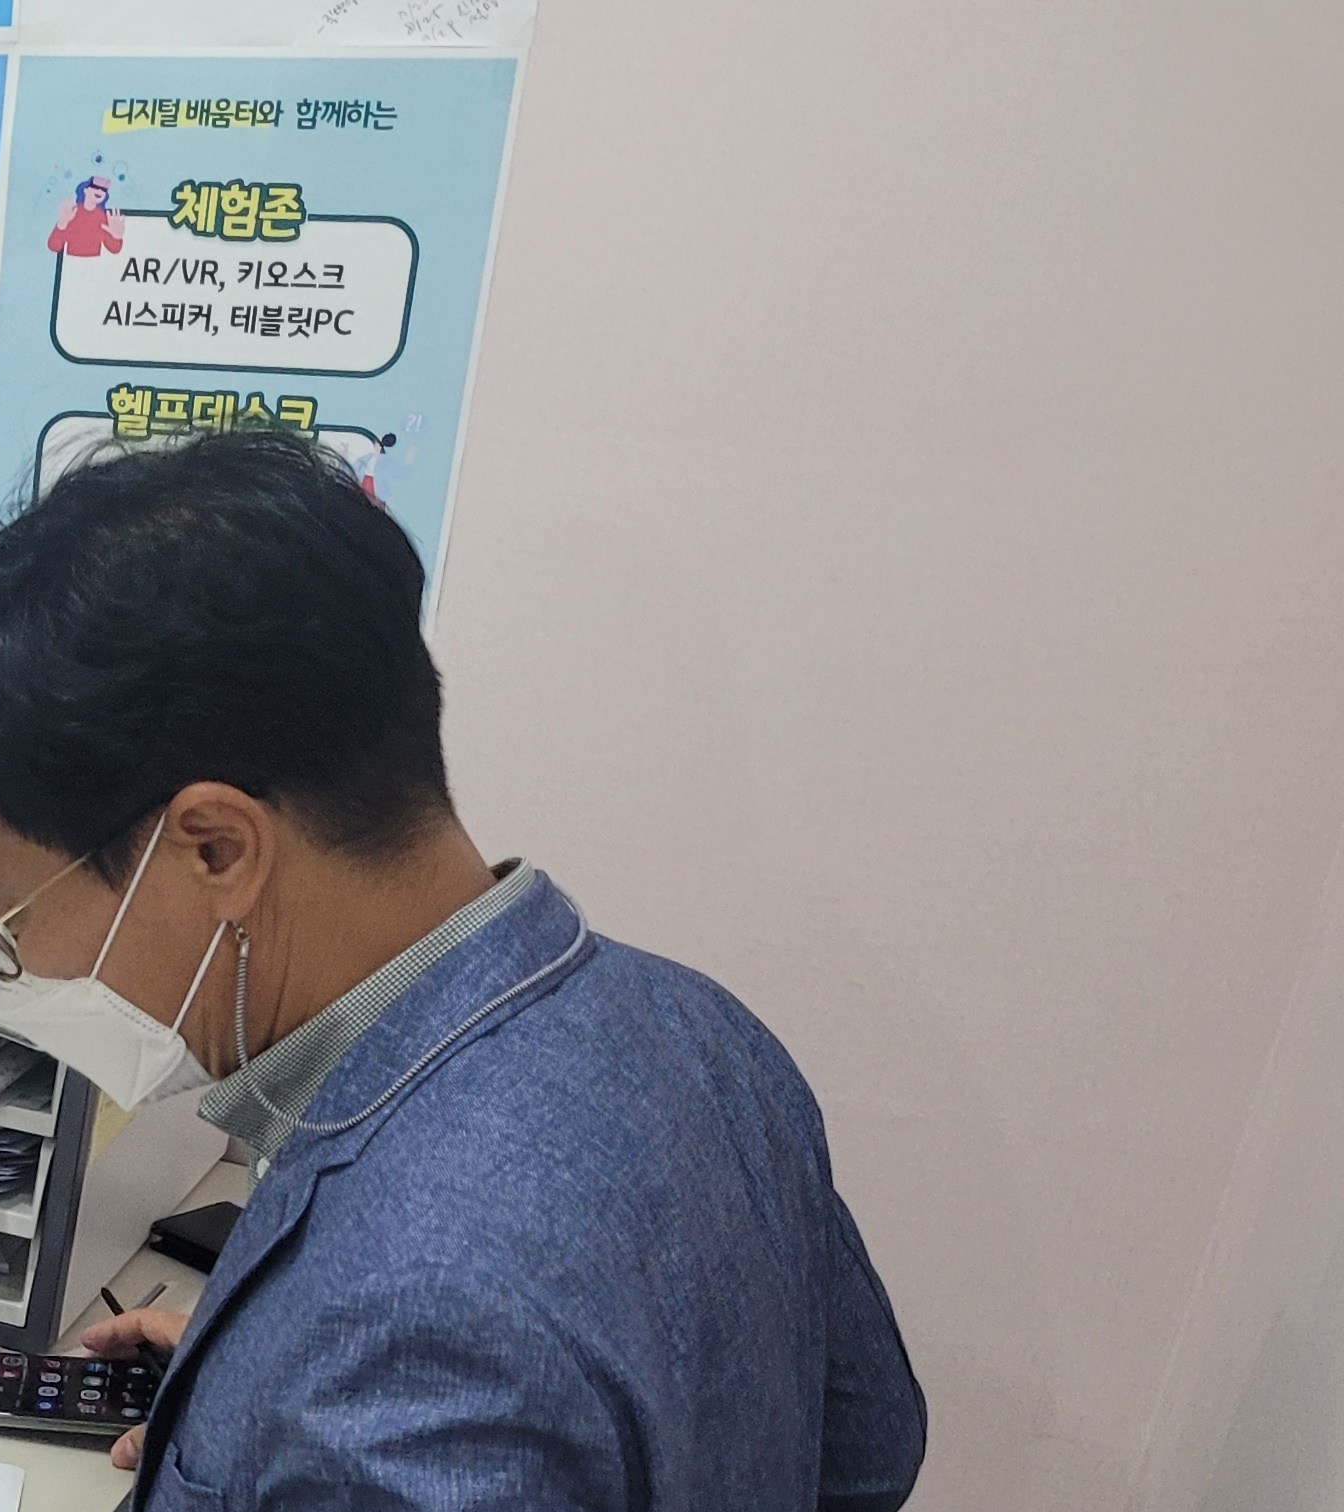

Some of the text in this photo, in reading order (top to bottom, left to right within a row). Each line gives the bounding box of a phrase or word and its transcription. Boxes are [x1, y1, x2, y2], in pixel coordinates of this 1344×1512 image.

[111, 98, 398, 131] 디지털 배움터와 함께하는
[171, 181, 306, 241] 체험존
[120, 257, 345, 291] AR/VR, 키오스크
[103, 302, 354, 339] AI스피커, 테블릿PC
